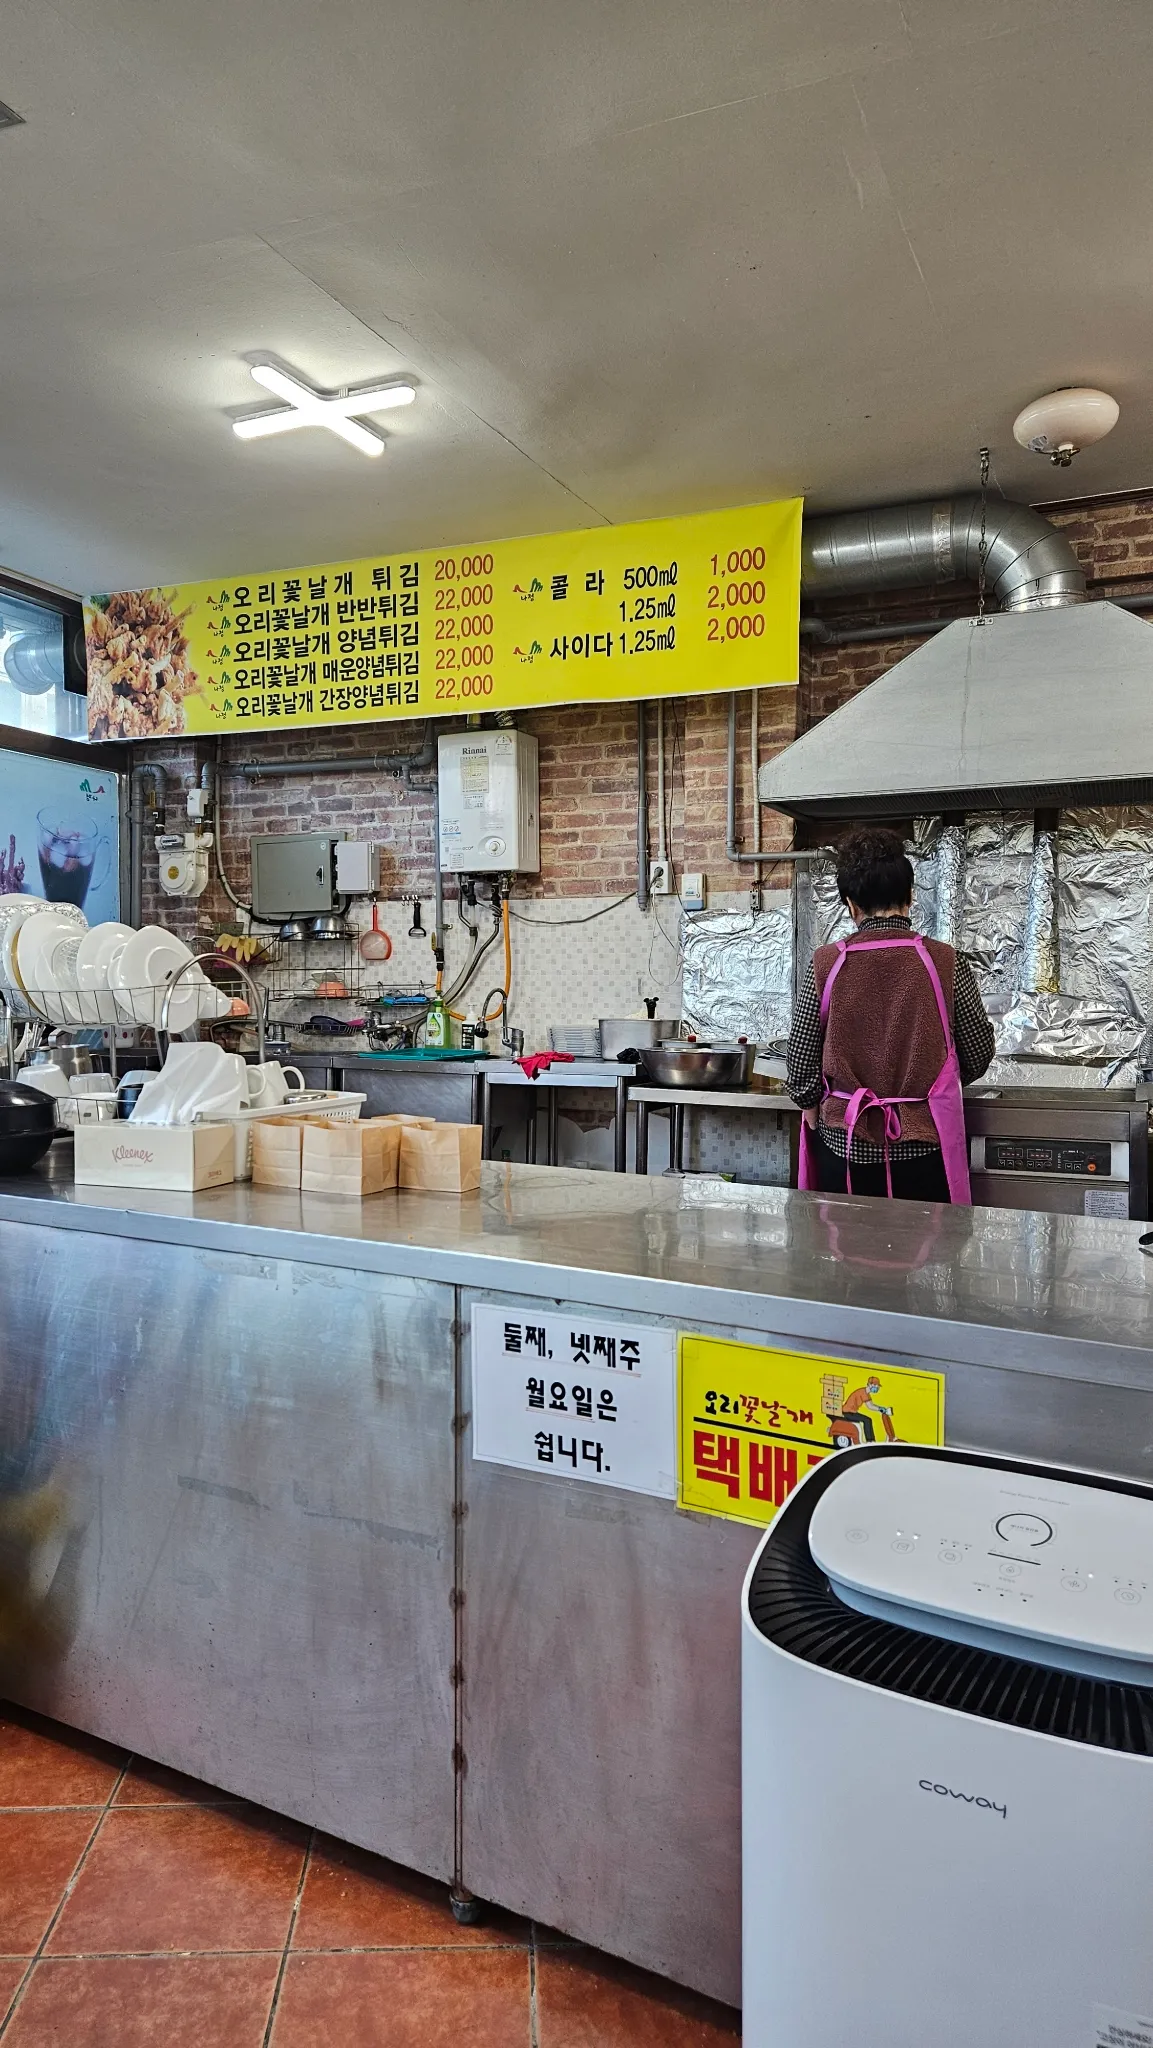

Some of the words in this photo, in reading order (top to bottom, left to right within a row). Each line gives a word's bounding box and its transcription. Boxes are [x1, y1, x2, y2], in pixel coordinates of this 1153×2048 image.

[434, 554, 494, 582] 20,000
[710, 546, 766, 578] 1,000
[233, 602, 330, 635] 오리꽃날개
[336, 591, 420, 624] 반반튀김
[434, 584, 494, 612] 22,000
[707, 580, 766, 611] 2,000
[233, 630, 331, 663] 오리꽃날개
[337, 621, 420, 654] 양념튀김
[434, 614, 494, 641] 22,000
[550, 632, 613, 660] 사이다
[706, 614, 765, 644] 2,000
[234, 661, 316, 690] 오리꽃날개
[322, 650, 420, 682] 매운양념튀김
[435, 644, 494, 671] 22,000
[236, 688, 314, 718] 오리꽃날개
[319, 680, 420, 712] 간장양념튀김
[435, 674, 494, 700] 22,000
[462, 746, 486, 755] Rinnai
[112, 1145, 154, 1164] Kleenex
[502, 1322, 553, 1361] 둘째,
[570, 1330, 641, 1372] 넷째주
[525, 1376, 618, 1423] 월요일은
[704, 1390, 814, 1428] 오리꽃날개
[534, 1430, 611, 1474] 쉽니다.
[694, 1430, 825, 1508] 택배
[918, 1779, 1007, 1819] coway
